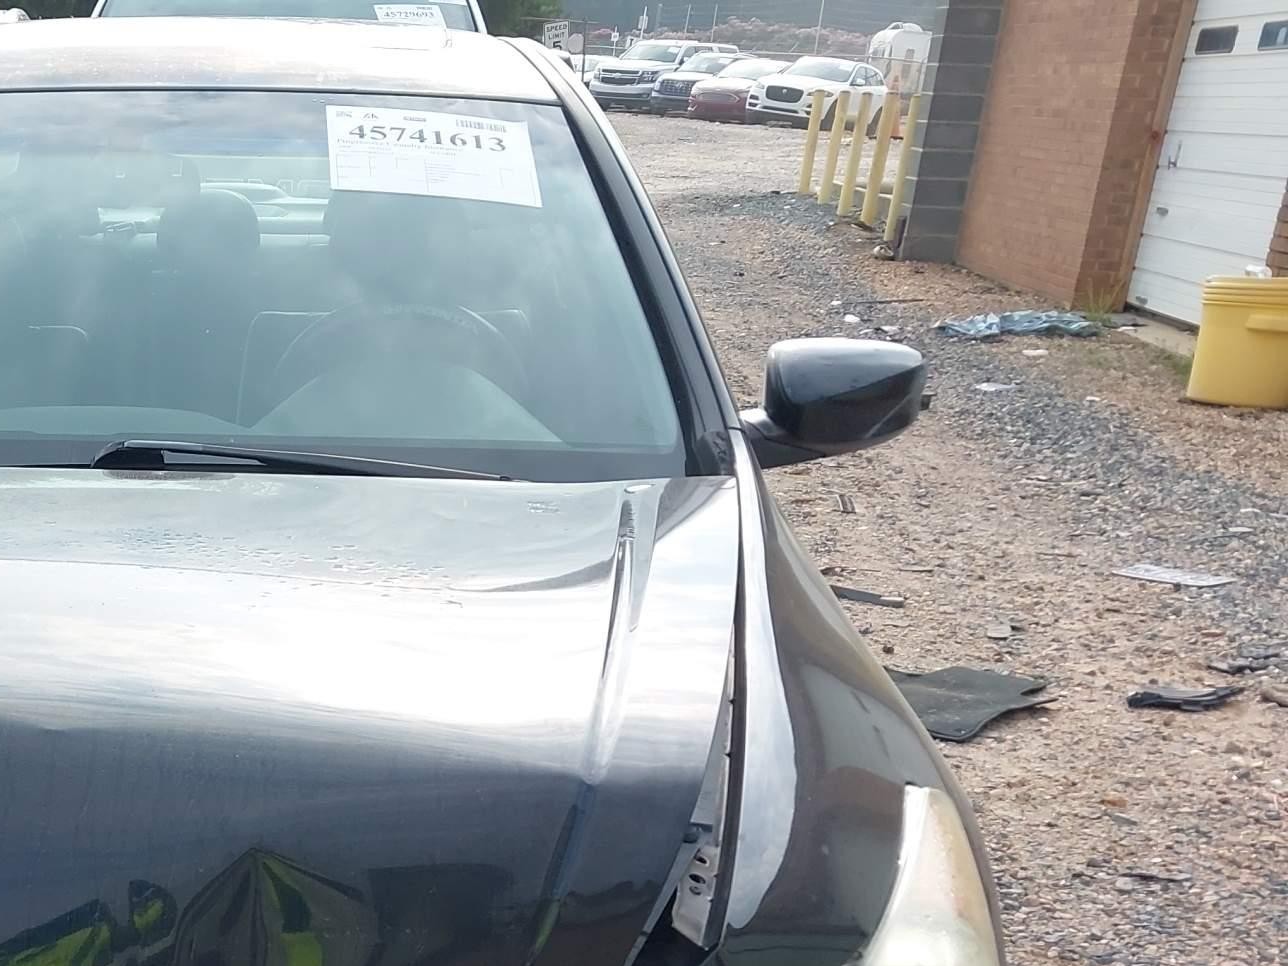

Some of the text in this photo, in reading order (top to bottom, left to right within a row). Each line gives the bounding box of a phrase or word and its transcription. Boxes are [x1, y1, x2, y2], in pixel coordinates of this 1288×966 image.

[546, 23, 567, 32] SPEED
[548, 31, 565, 40] LIMIT
[349, 124, 507, 152] 45741613
